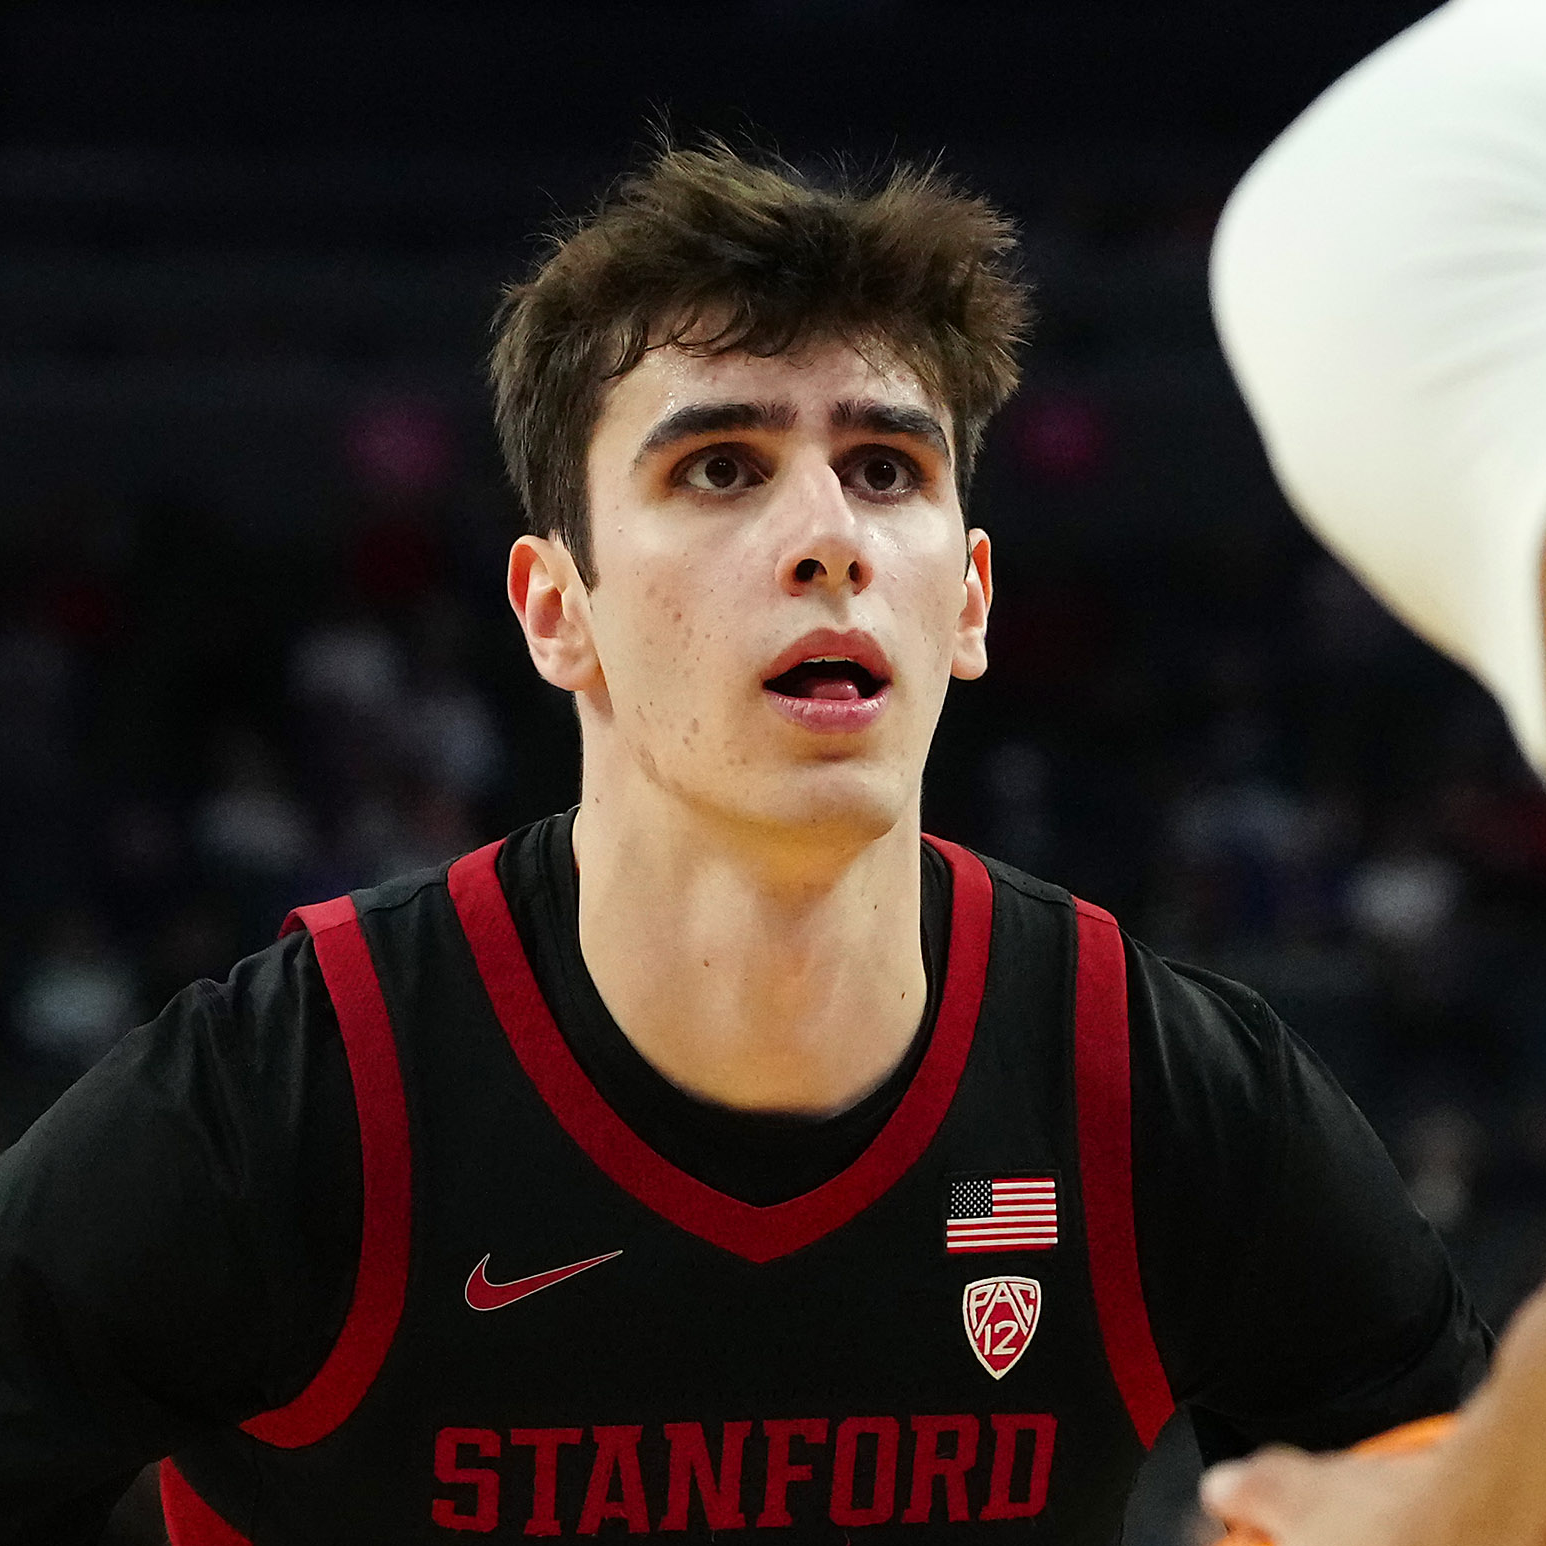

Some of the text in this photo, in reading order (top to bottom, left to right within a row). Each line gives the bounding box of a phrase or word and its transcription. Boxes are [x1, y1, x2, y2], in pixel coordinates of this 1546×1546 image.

[968, 1282, 1036, 1339] PAC
[983, 1319, 1019, 1356] 12
[430, 1412, 1058, 1536] STANFORD
